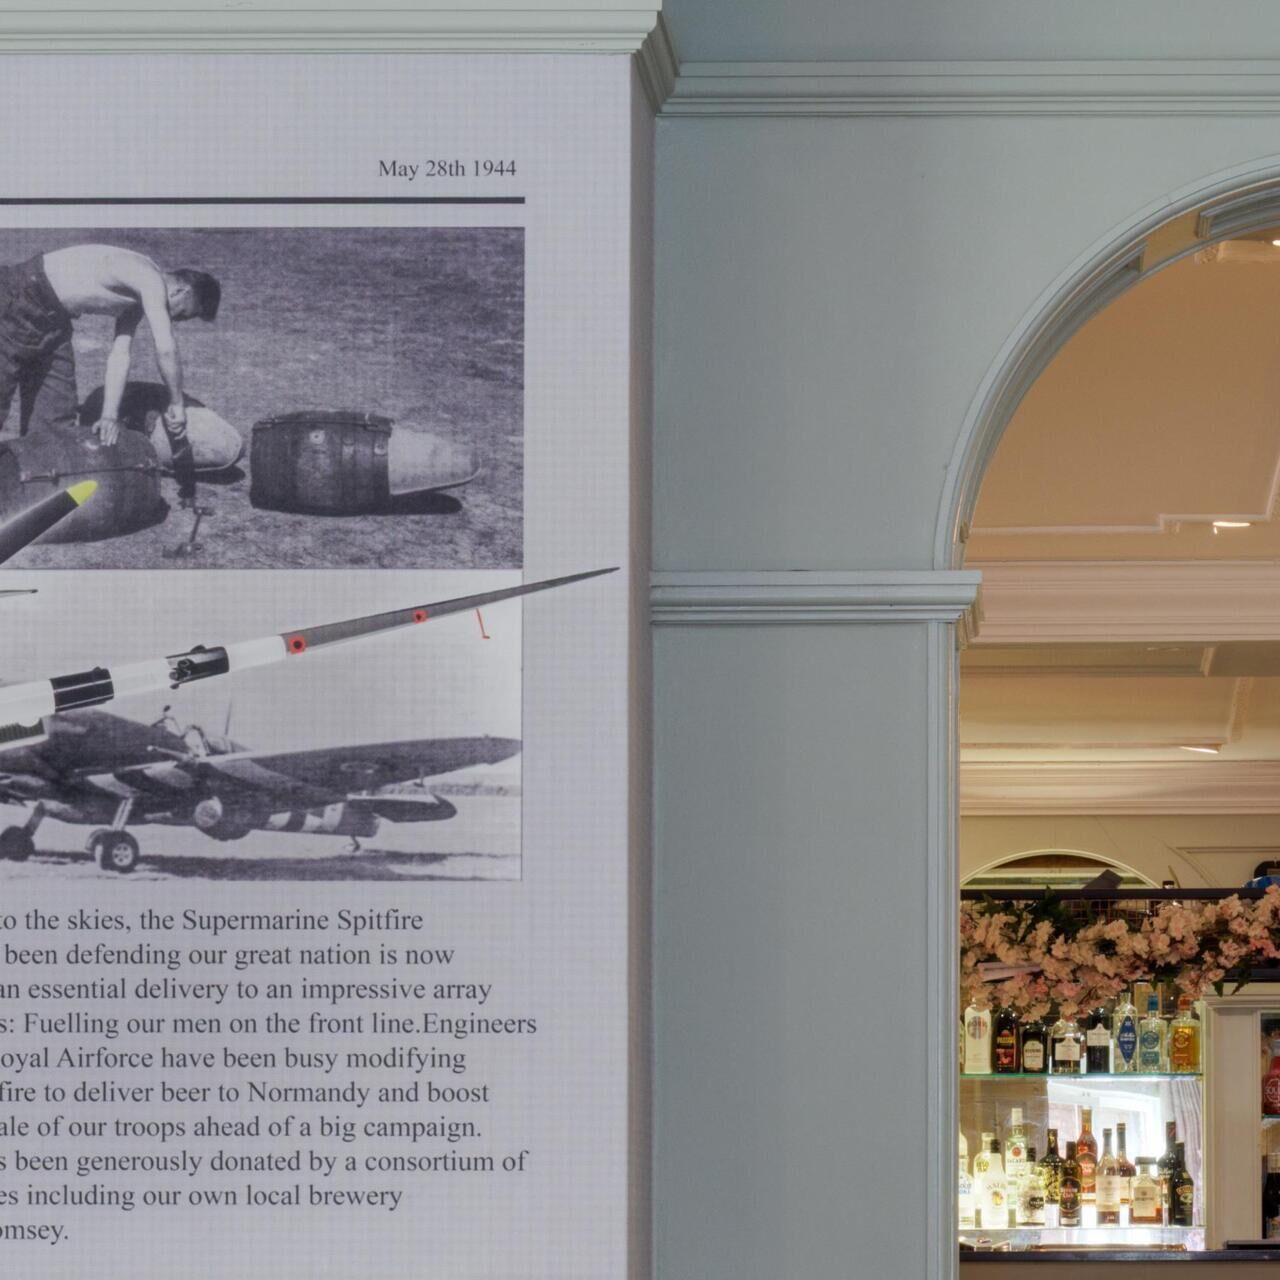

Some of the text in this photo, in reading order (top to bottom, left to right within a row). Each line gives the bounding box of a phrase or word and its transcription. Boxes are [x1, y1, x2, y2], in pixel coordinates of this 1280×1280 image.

[380, 160, 516, 181] May 28th 1944
[25, 909, 59, 930] the
[68, 909, 131, 932] skies,
[140, 909, 174, 930] the
[183, 909, 328, 936] Supermarine
[338, 909, 423, 936] Spitfire
[5, 944, 57, 964] been
[66, 943, 181, 970] defending
[189, 950, 227, 964] our
[235, 947, 291, 970] great
[300, 944, 370, 964] nation
[380, 944, 397, 964] is
[406, 950, 454, 964] now
[28, 978, 125, 999] essential
[135, 978, 228, 1004] delivery
[237, 981, 258, 999] to
[266, 984, 292, 999] an
[302, 978, 425, 1005] impressive
[433, 984, 492, 1005] array
[25, 1012, 119, 1039] Fuelling
[127, 1019, 165, 1033] our
[173, 1019, 221, 1033] men
[230, 1019, 256, 1033] on
[266, 1012, 300, 1033] the
[310, 1012, 363, 1033] front
[56, 1047, 153, 1068] Airforce
[162, 1047, 215, 1068] have
[223, 1047, 276, 1068] been
[285, 1047, 338, 1074] busy
[347, 1047, 466, 1074] modifying
[44, 1085, 65, 1102] to
[74, 1081, 154, 1102] deliver
[161, 1081, 211, 1102] beer
[218, 1085, 239, 1102] to
[248, 1081, 370, 1108] Normandy
[379, 1081, 419, 1102] and
[428, 1081, 489, 1102] boost
[37, 1115, 64, 1136] of
[69, 1122, 107, 1136] our
[115, 1120, 186, 1142] troops
[194, 1116, 259, 1136] ahead
[268, 1115, 295, 1136] of
[300, 1122, 311, 1136] a
[320, 1116, 356, 1142] big
[364, 1116, 481, 1143] campaign.
[15, 1150, 68, 1171] been
[77, 1150, 202, 1176] generously
[210, 1150, 301, 1171] donated
[309, 1150, 336, 1176] by
[345, 1156, 356, 1171] a
[365, 1150, 494, 1171] consortium
[502, 1150, 530, 1171] of
[28, 1184, 135, 1211] including
[143, 1191, 181, 1205] our
[189, 1191, 237, 1205] own
[247, 1184, 300, 1205] local
[309, 1184, 402, 1211] brewery
